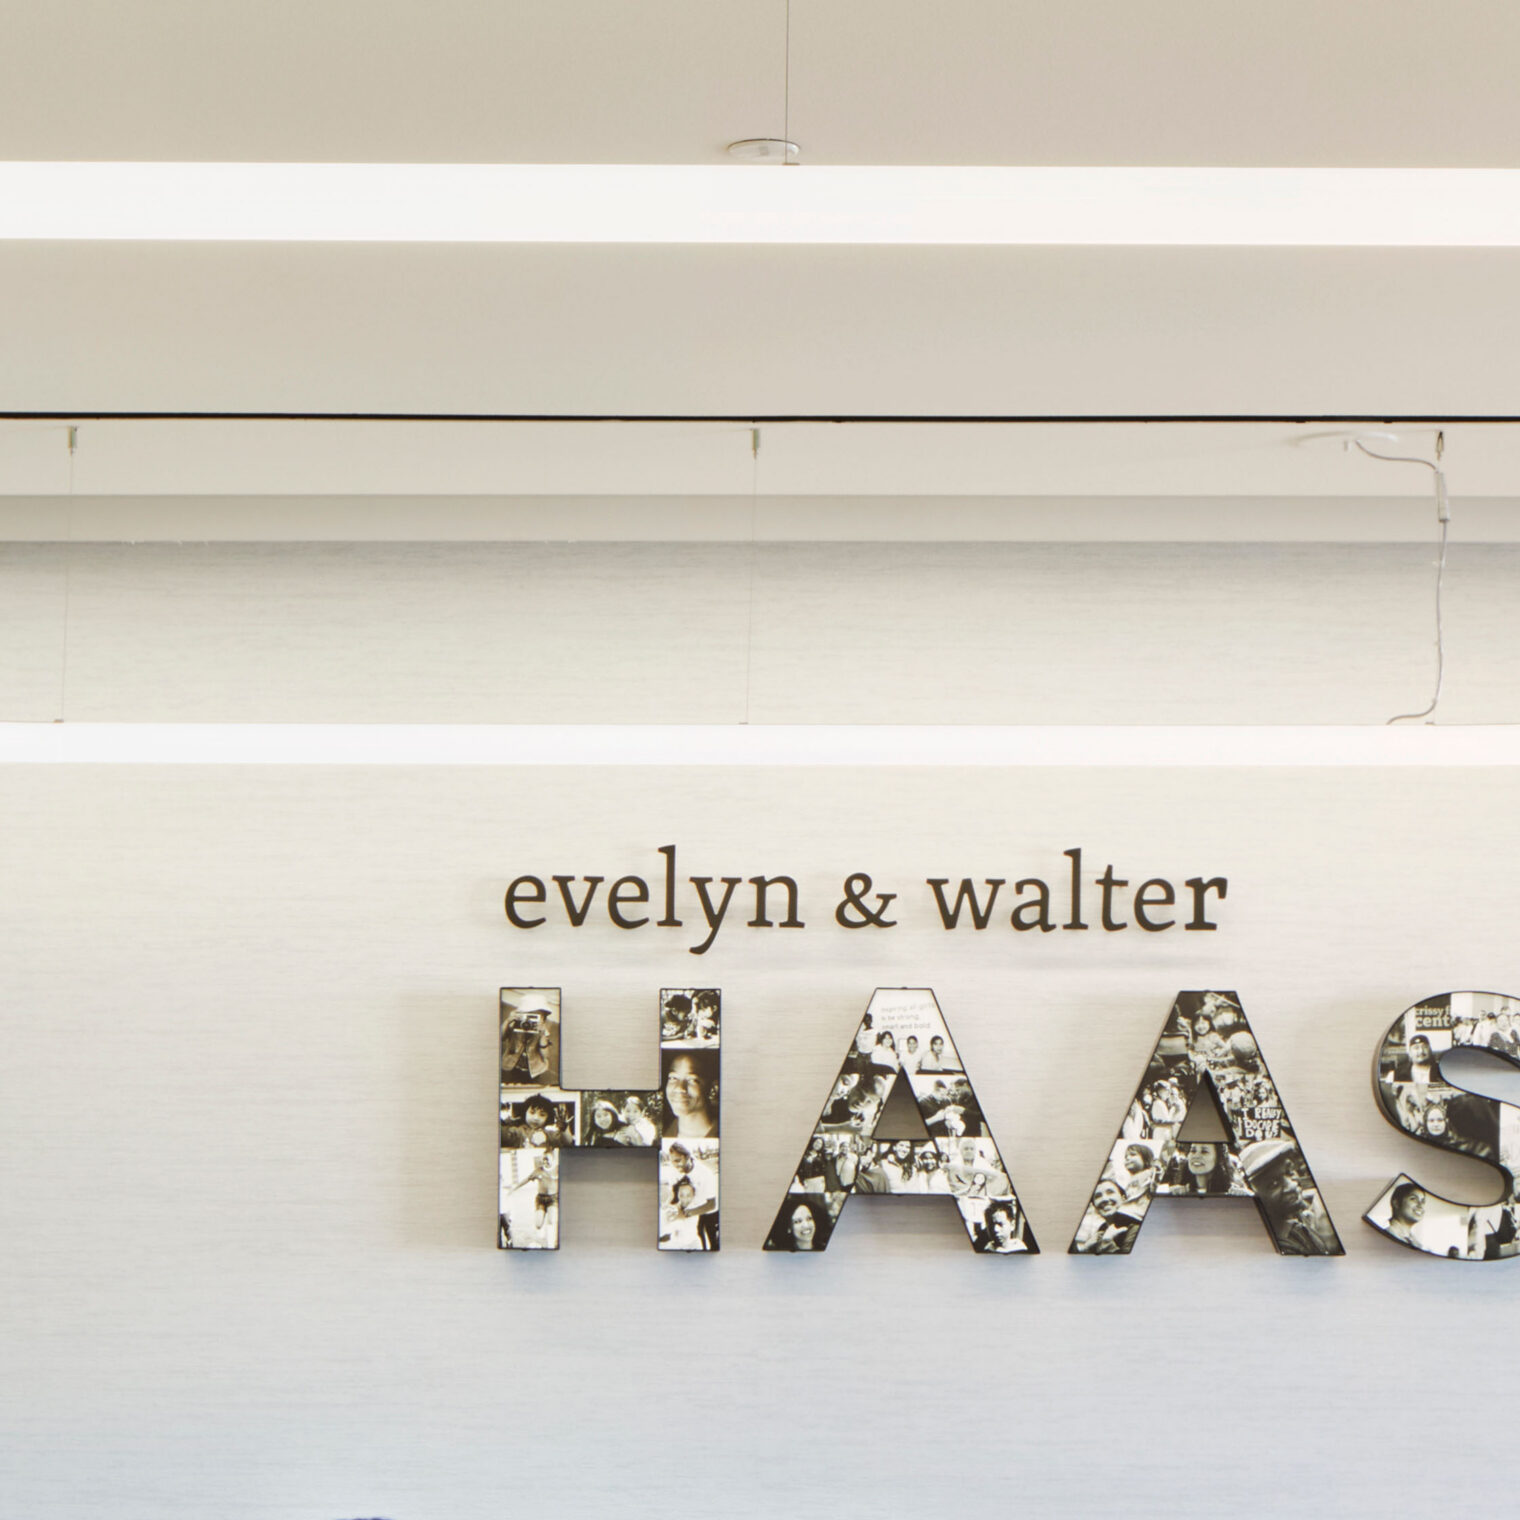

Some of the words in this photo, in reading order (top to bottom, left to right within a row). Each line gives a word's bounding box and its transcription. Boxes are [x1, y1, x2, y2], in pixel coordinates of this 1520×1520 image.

[505, 845, 805, 955] evelyn
[835, 873, 897, 930] &
[926, 848, 1228, 933] walter
